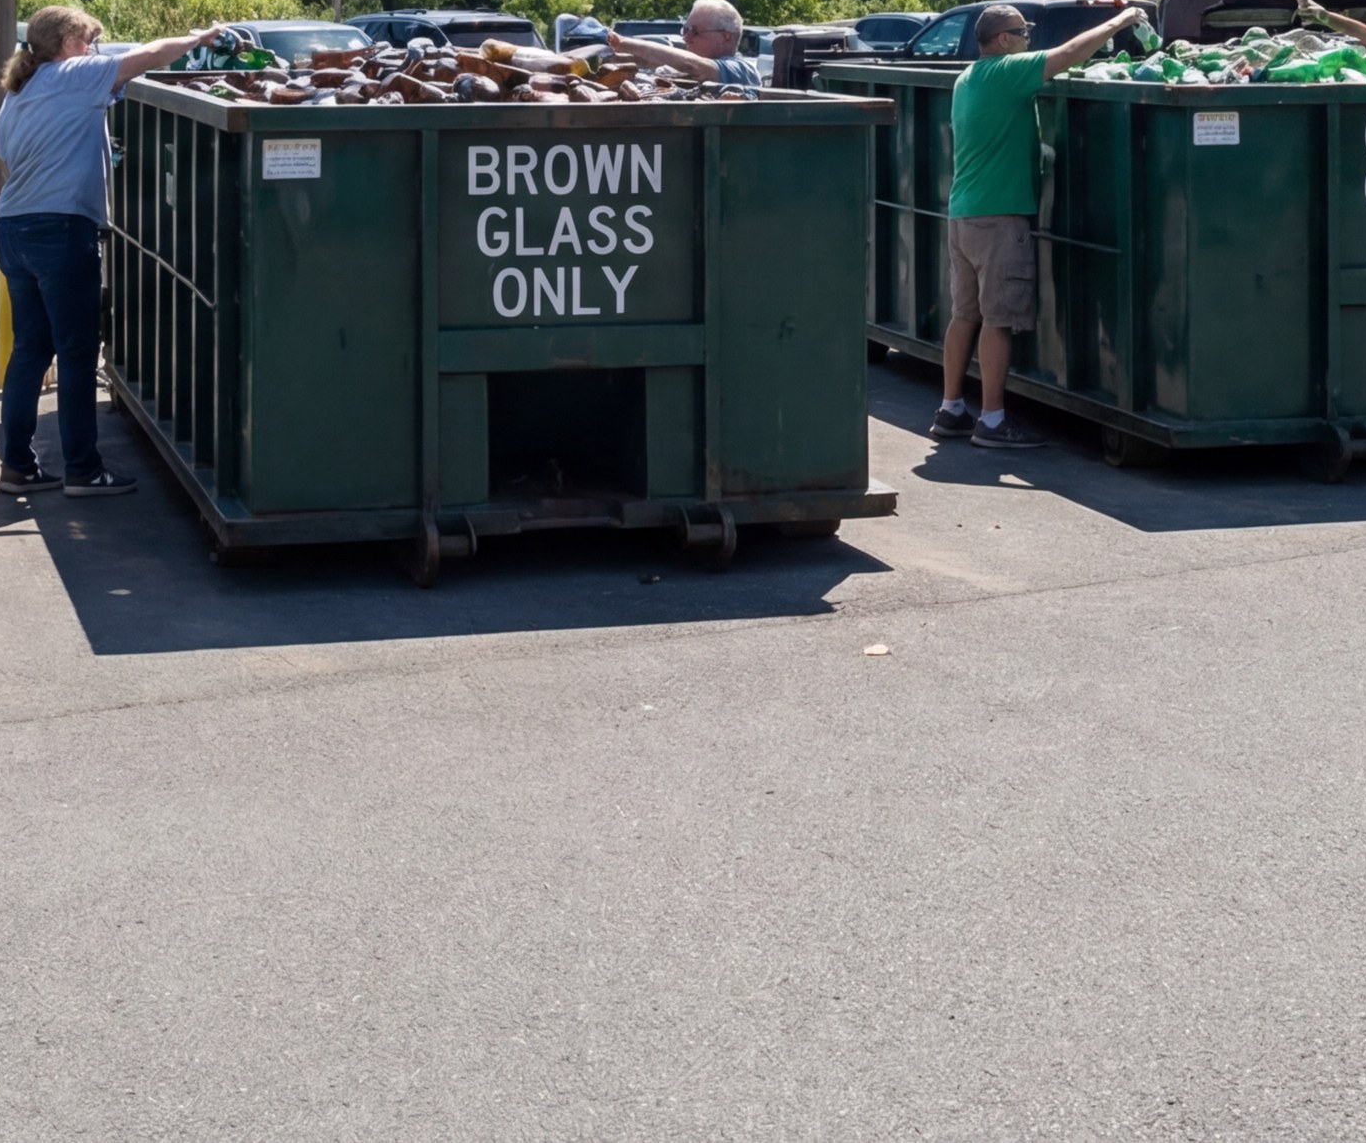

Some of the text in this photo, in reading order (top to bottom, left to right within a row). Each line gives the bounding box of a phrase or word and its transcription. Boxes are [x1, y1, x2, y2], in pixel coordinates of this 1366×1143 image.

[468, 144, 662, 195] BROWN
[477, 204, 654, 257] GLASS
[493, 265, 639, 318] ONLY
